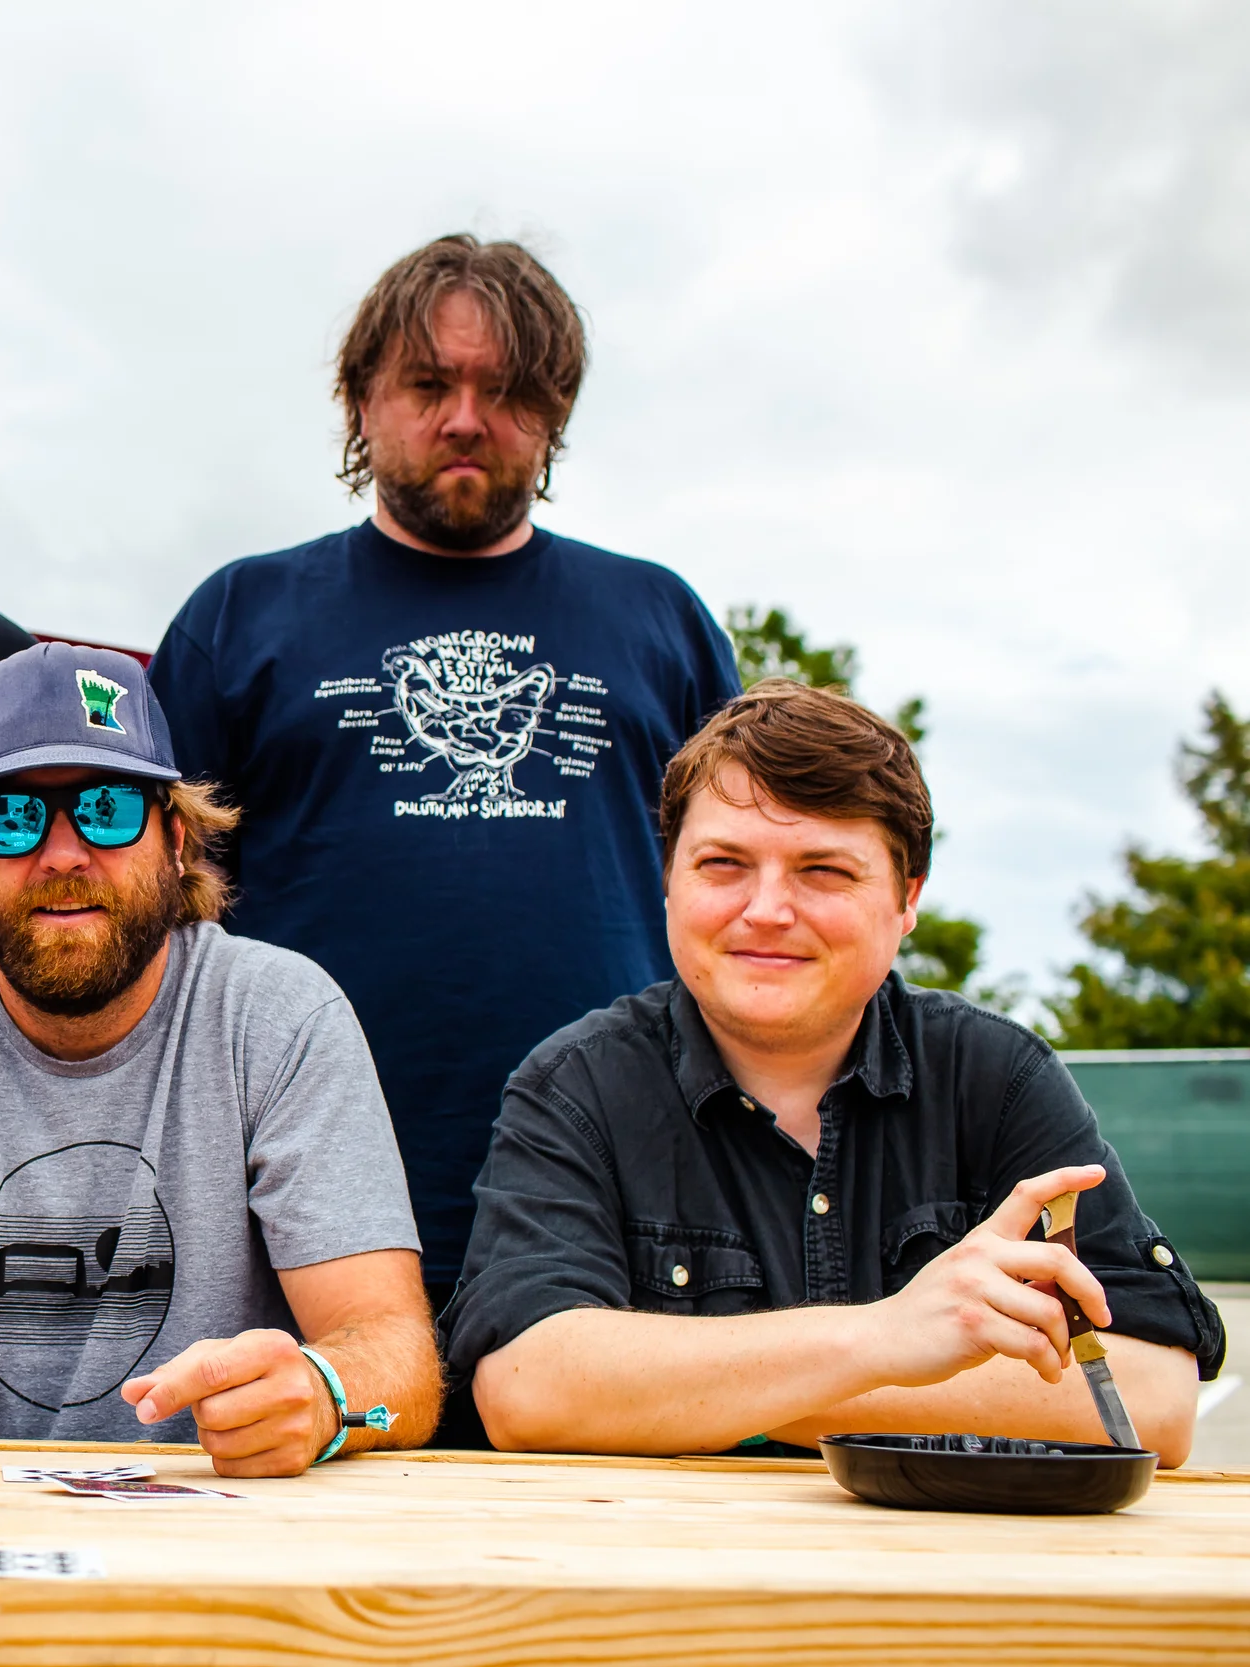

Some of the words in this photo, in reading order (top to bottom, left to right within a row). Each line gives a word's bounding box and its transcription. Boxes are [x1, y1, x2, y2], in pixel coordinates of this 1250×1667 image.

[409, 629, 535, 657] HOMEGROWN
[437, 645, 504, 663] MUSIC
[429, 659, 518, 678] FESTIVAL
[314, 685, 382, 698] Equilibrium
[447, 674, 497, 694] 2016
[344, 709, 373, 719] Horn
[338, 718, 379, 729] Section
[470, 768, 500, 783] MAY
